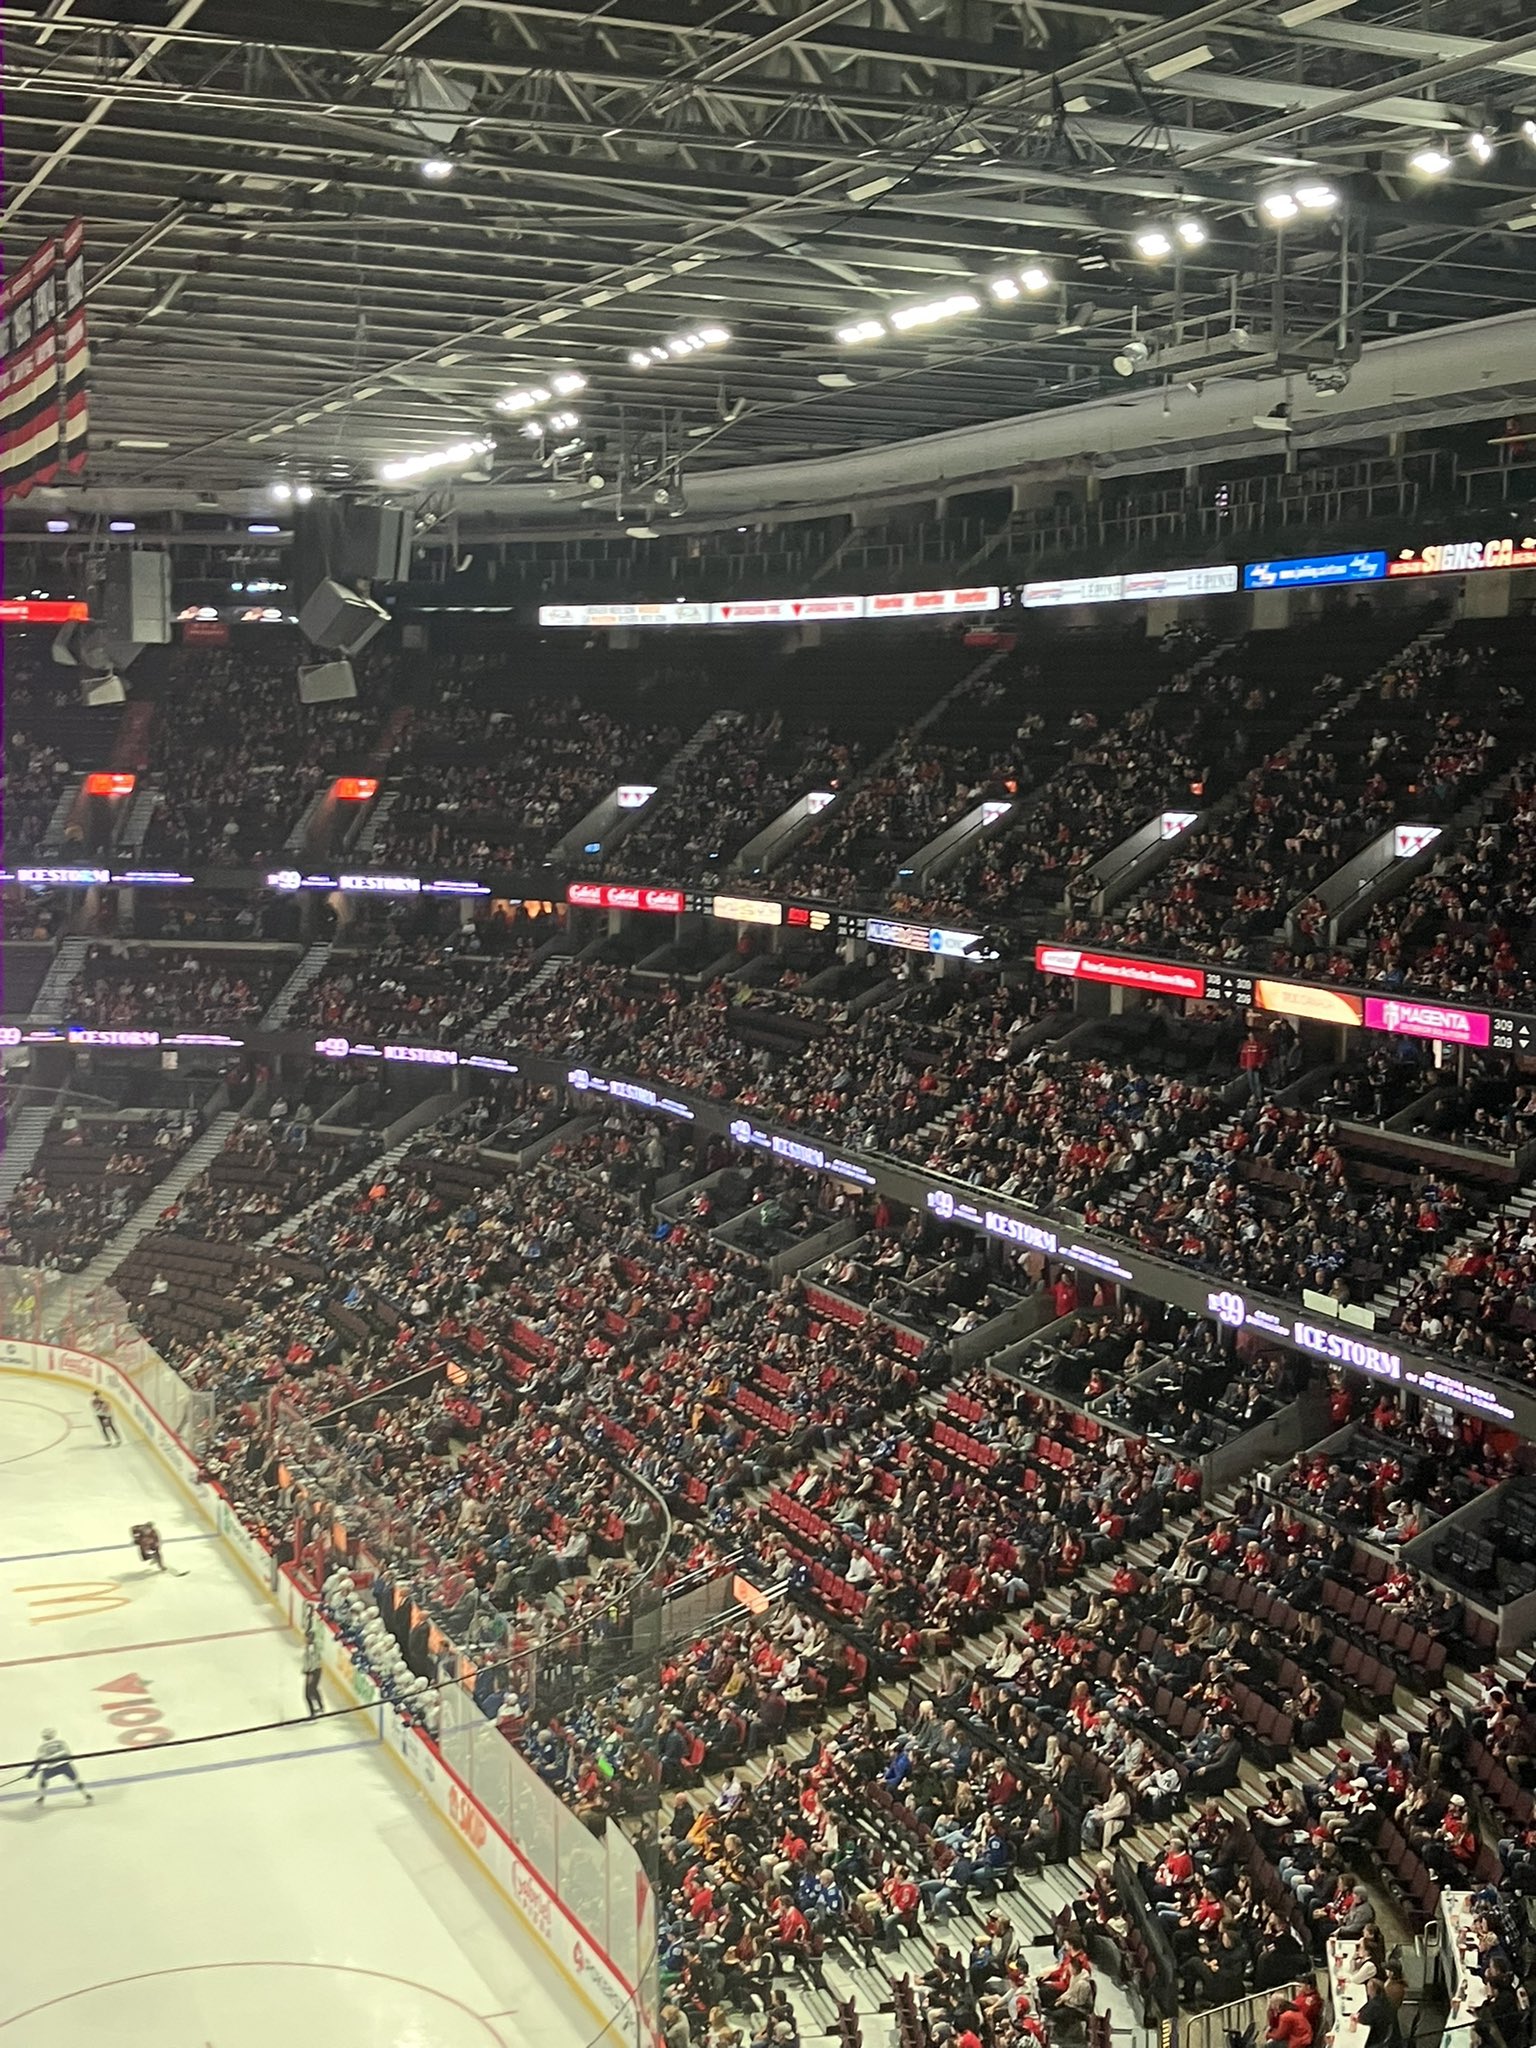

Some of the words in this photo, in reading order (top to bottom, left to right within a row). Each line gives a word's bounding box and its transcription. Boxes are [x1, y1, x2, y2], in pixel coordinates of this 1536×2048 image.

[1421, 539, 1514, 574] SIGNS.CA
[1400, 1006, 1471, 1032] MAGENTA
[1493, 1019, 1514, 1032] 309
[1493, 1036, 1513, 1049] 209
[1294, 1322, 1401, 1380] ICESTORM
